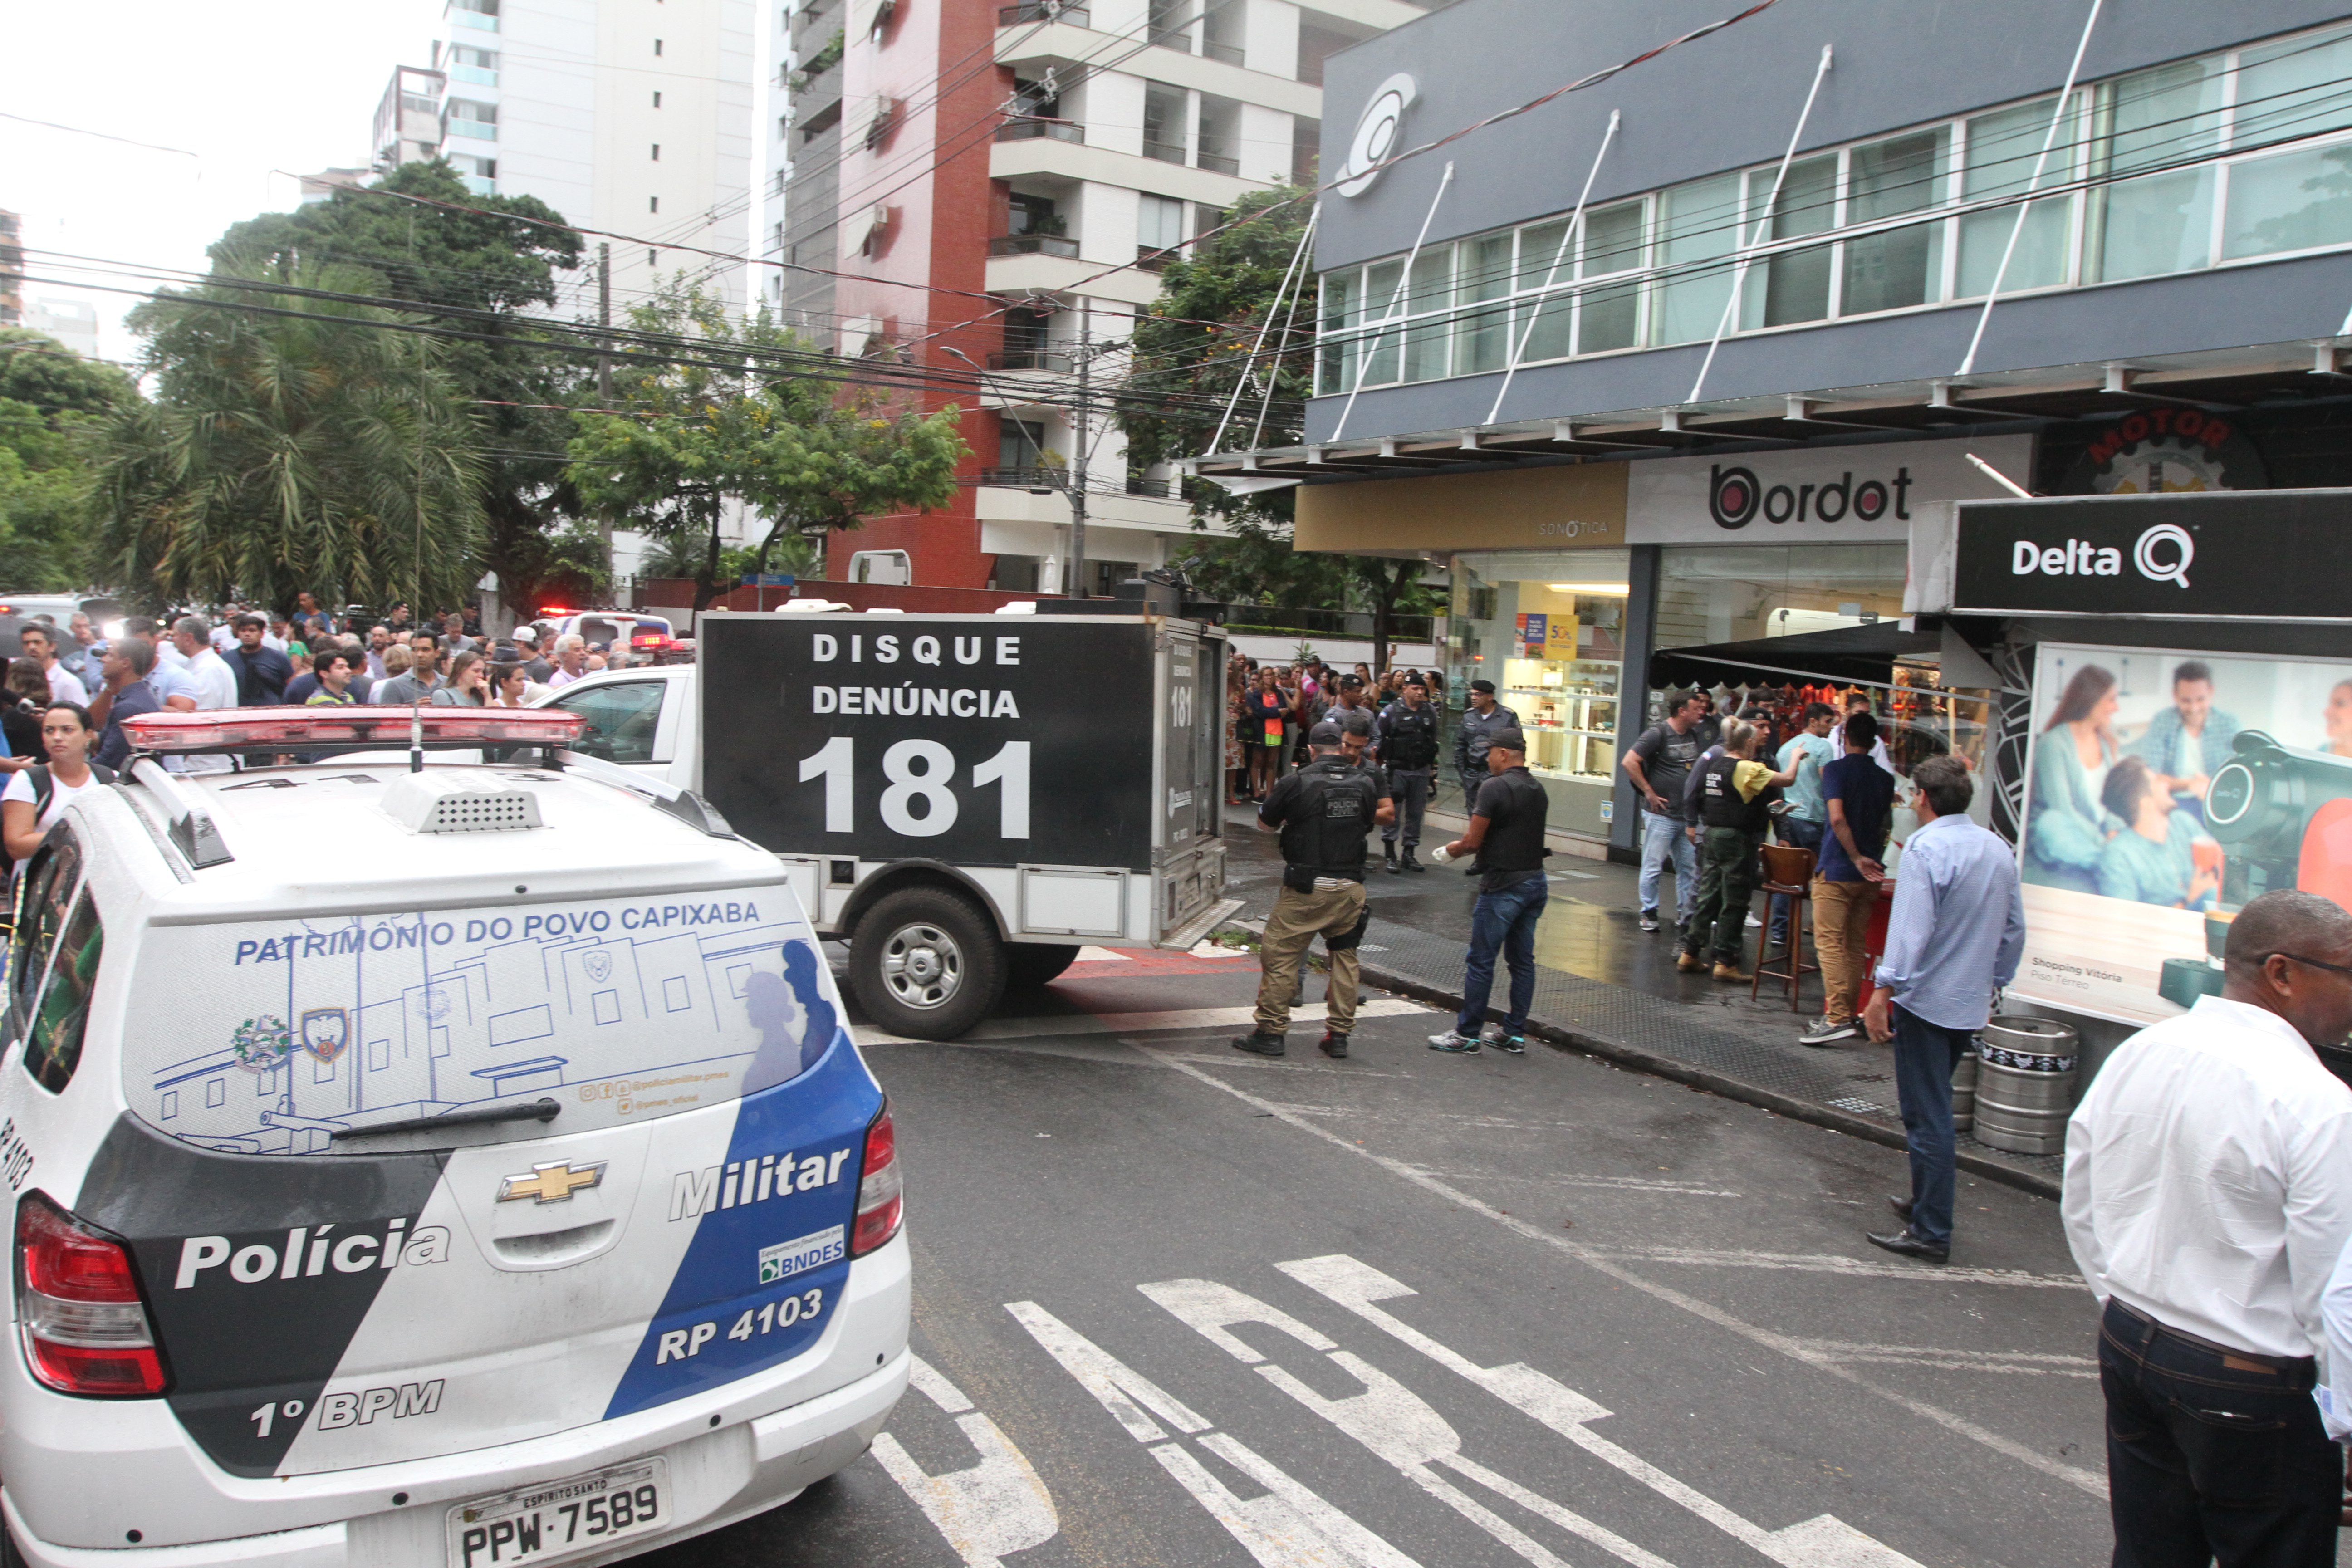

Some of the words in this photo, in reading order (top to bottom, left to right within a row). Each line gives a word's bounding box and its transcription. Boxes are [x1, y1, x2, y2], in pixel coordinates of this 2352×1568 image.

[2089, 409, 2230, 464] MOTOR
[1710, 464, 1913, 530] bordot
[2012, 539, 2122, 575] Delta
[2134, 524, 2194, 588] Q
[813, 634, 1020, 666] DISQUE
[813, 681, 1020, 719] DENÚNCIA
[1171, 686, 1192, 727] 181
[799, 736, 1031, 839] 181
[235, 921, 454, 965] PATRIMÔNIO
[466, 917, 513, 943] DO
[524, 911, 611, 938] POVO
[622, 902, 760, 930] CAPIXABA
[2031, 970, 2052, 982] Piso
[2055, 975, 2089, 990] Térreo
[2032, 956, 2082, 976] Shopping
[2086, 968, 2122, 983] Vitória
[668, 1148, 851, 1222] Militar
[175, 1217, 451, 1289] Polícia
[781, 1240, 843, 1276] BNDES
[656, 1321, 717, 1366] RP
[728, 1288, 823, 1342] 4103
[318, 1379, 446, 1431] BPM
[573, 1479, 608, 1496] SANTO
